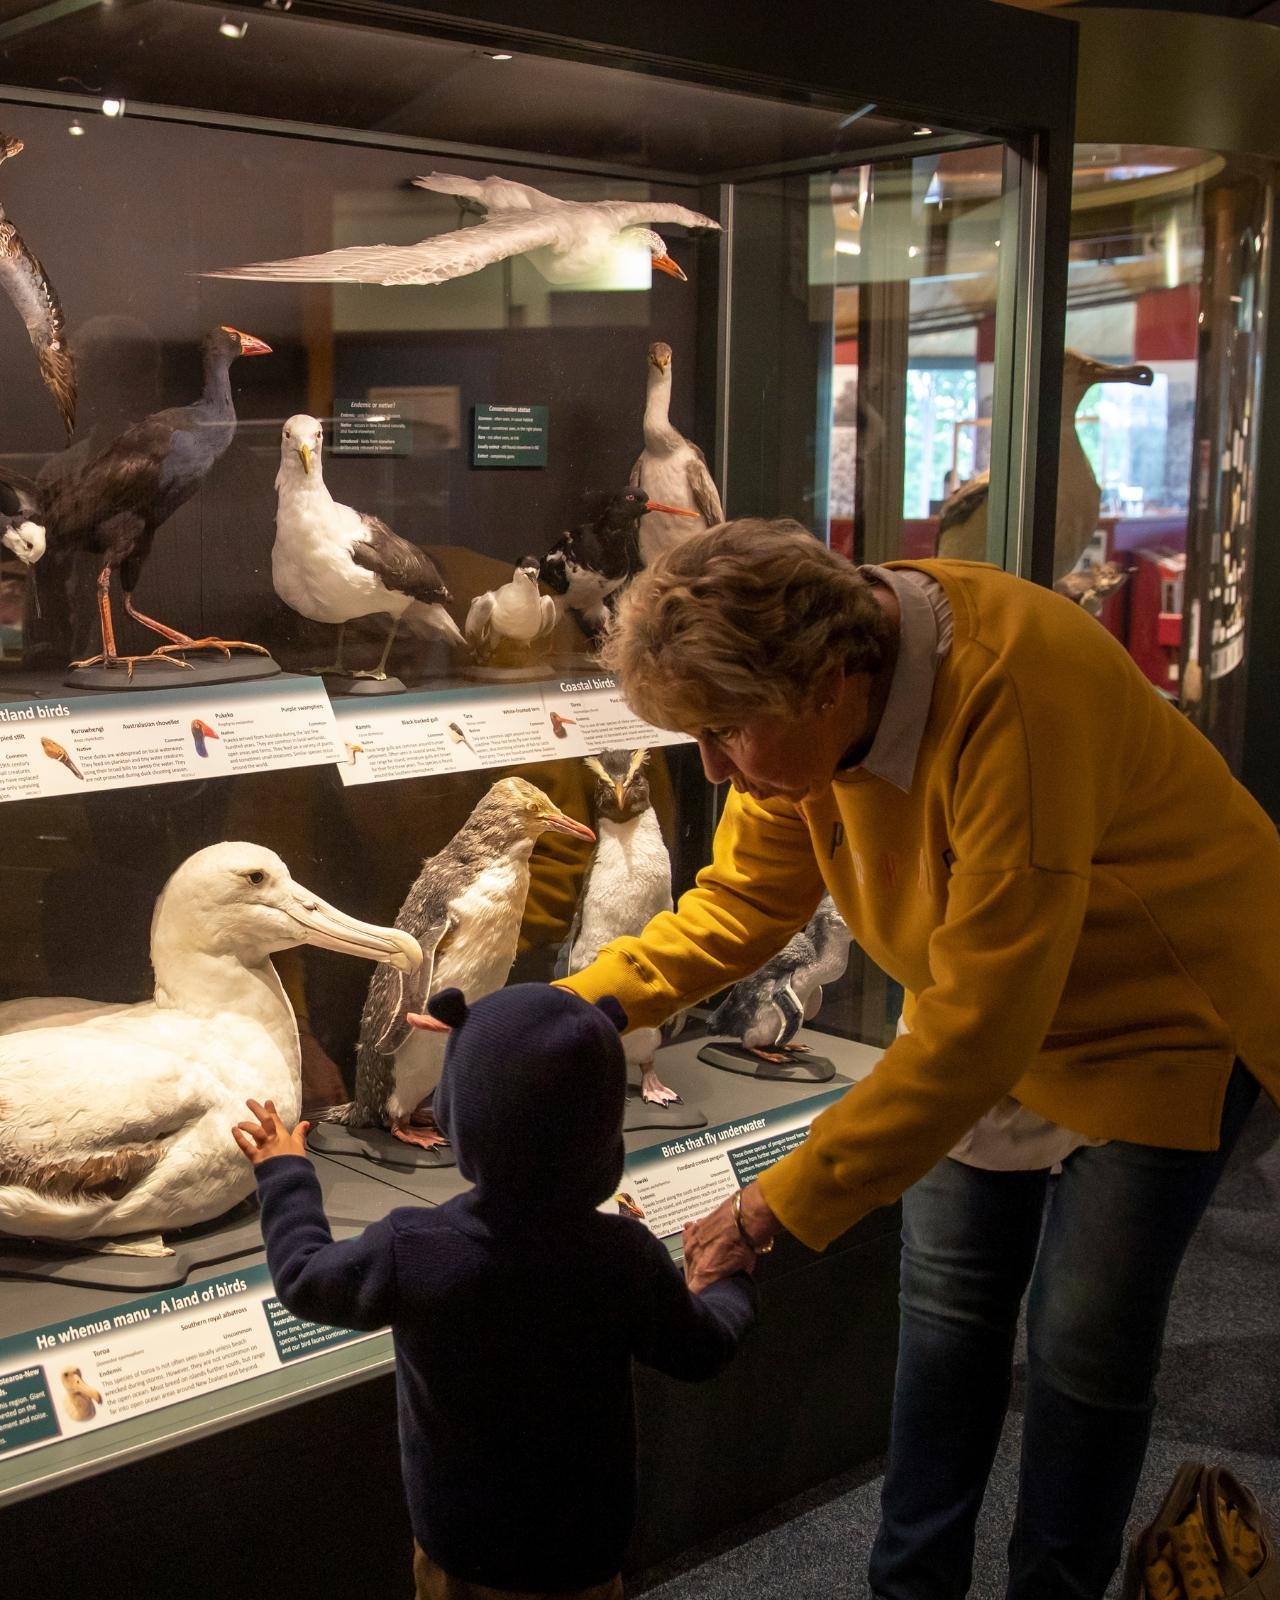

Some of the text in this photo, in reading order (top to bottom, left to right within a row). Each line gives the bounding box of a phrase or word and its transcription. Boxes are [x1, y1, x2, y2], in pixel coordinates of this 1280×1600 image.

[560, 678, 616, 692] Coastal birds
[37, 704, 70, 719] birds
[662, 1119, 766, 1158] Birds that fly underwater
[36, 1333, 55, 1349] He
[58, 1319, 110, 1343] whenua
[113, 1308, 149, 1328] manu
[160, 1299, 168, 1314] A
[172, 1290, 198, 1311] land
[201, 1286, 213, 1303] of
[217, 1278, 247, 1298] birds
[93, 1348, 110, 1357] Toroa
